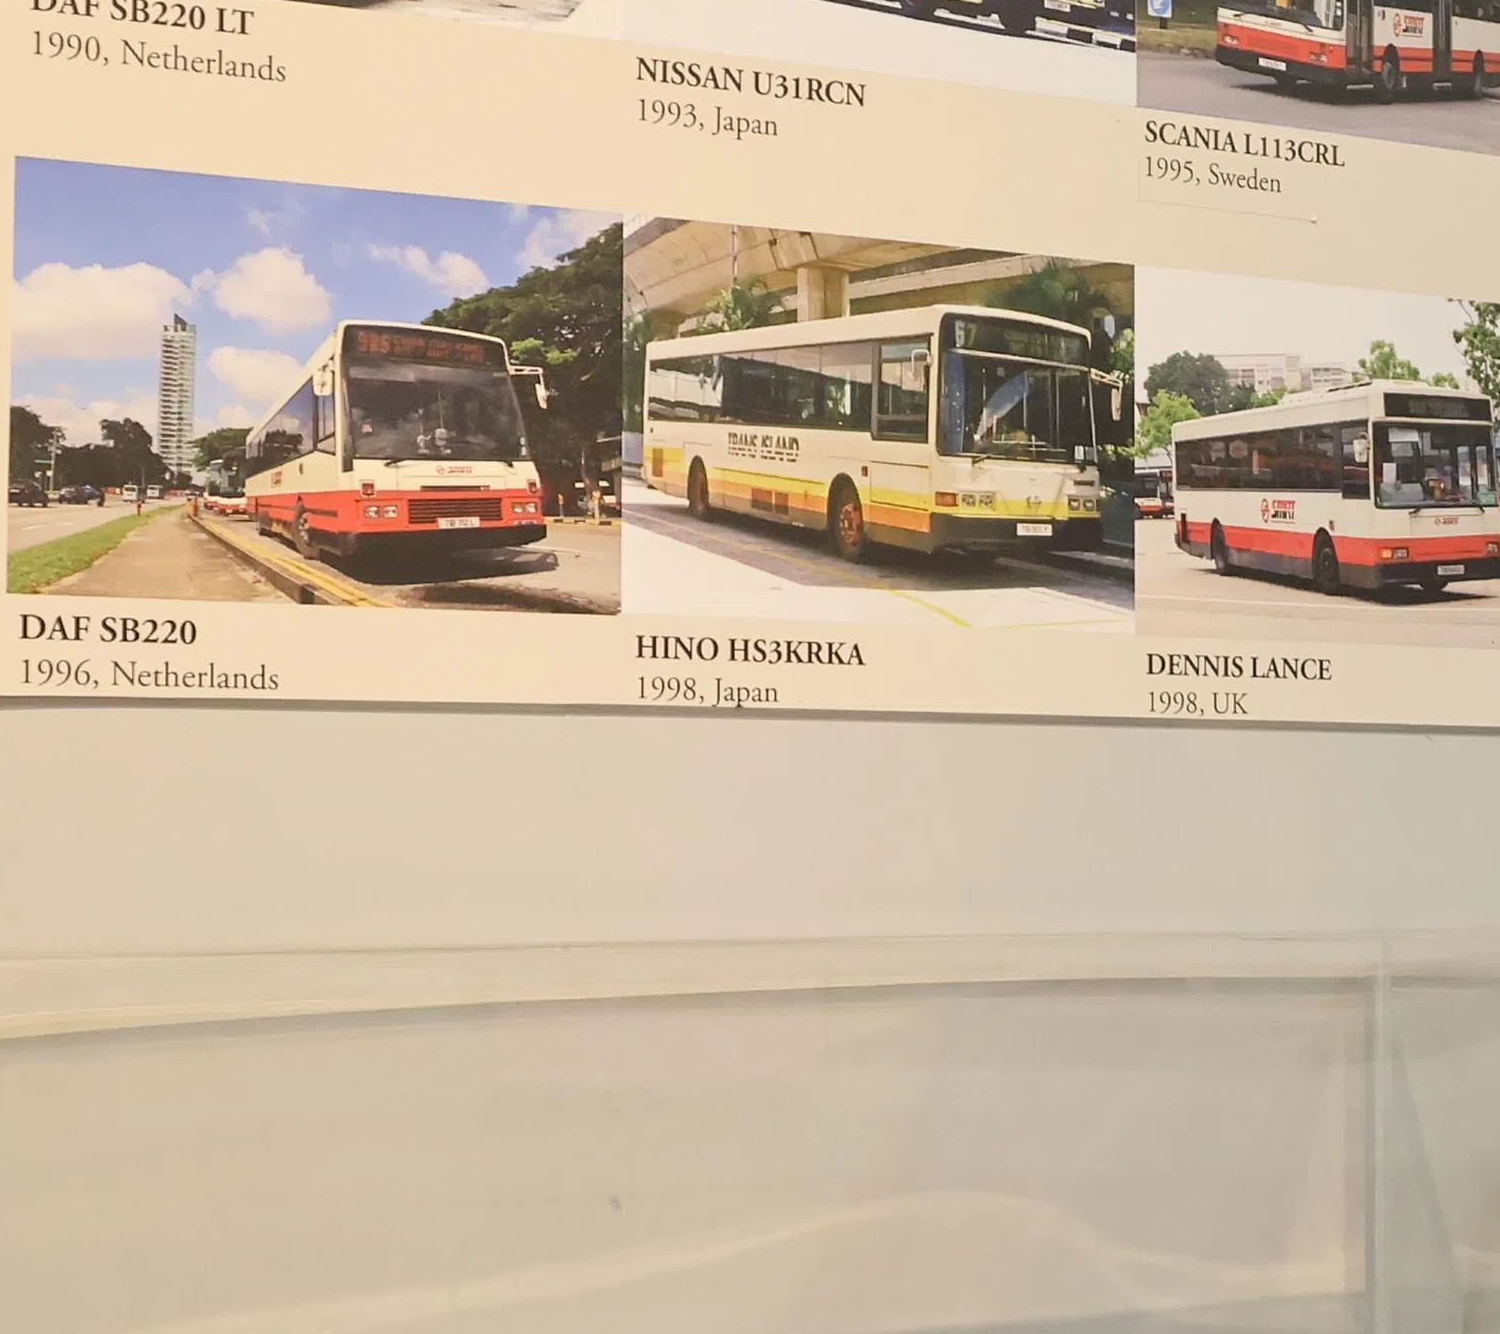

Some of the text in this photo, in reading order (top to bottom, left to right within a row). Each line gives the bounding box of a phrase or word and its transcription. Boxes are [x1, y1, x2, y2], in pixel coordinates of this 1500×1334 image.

[215, 7, 255, 36] LT
[31, 29, 288, 84] 1990, Netherlands
[636, 56, 867, 109] NISSAN U31RCN
[637, 97, 779, 140] 1993, Japan
[1144, 120, 1346, 169] SCANIA L113CRL
[1144, 154, 1283, 195] 1995, Sweden
[19, 613, 198, 647] DAF SB220
[635, 635, 867, 667] HINO HS3KRKA
[1146, 653, 1333, 681] DENNIS LANCE
[19, 658, 280, 693] 1996, Netherlands
[636, 675, 779, 709] 1998, Japan
[1147, 691, 1249, 717] 1998, UK
